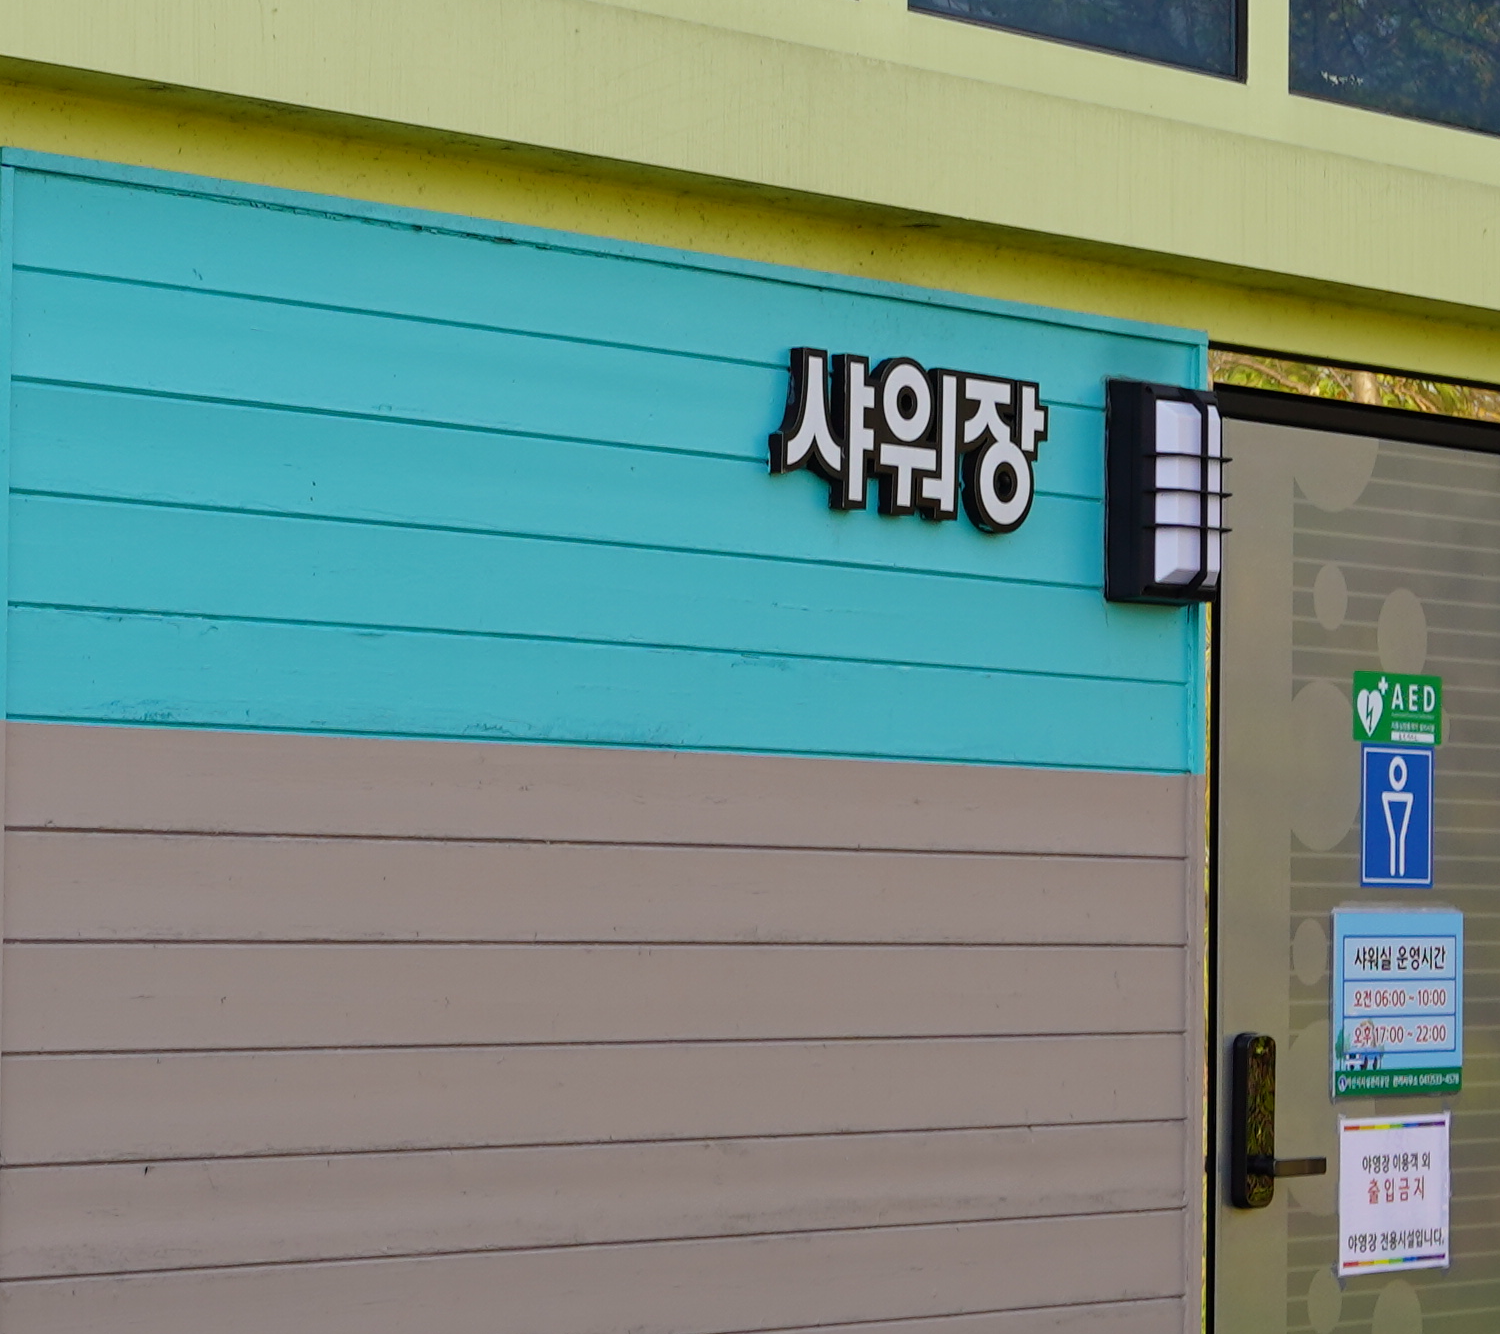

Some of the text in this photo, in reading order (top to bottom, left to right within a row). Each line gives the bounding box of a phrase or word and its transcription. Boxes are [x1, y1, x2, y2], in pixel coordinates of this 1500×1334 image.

[770, 347, 1048, 534] 샤워장
[1391, 682, 1436, 713] AED
[1354, 945, 1446, 971] 샤워실 운영시간
[1354, 989, 1372, 1008] 오전
[1375, 990, 1406, 1007] 06:00
[1418, 989, 1446, 1007] 10:00
[1354, 1026, 1372, 1046] 오후
[1375, 1026, 1404, 1044] 17:00
[1416, 1025, 1446, 1042] 22:00
[1392, 1152, 1418, 1172] 이용객
[1422, 1151, 1430, 1170] 외
